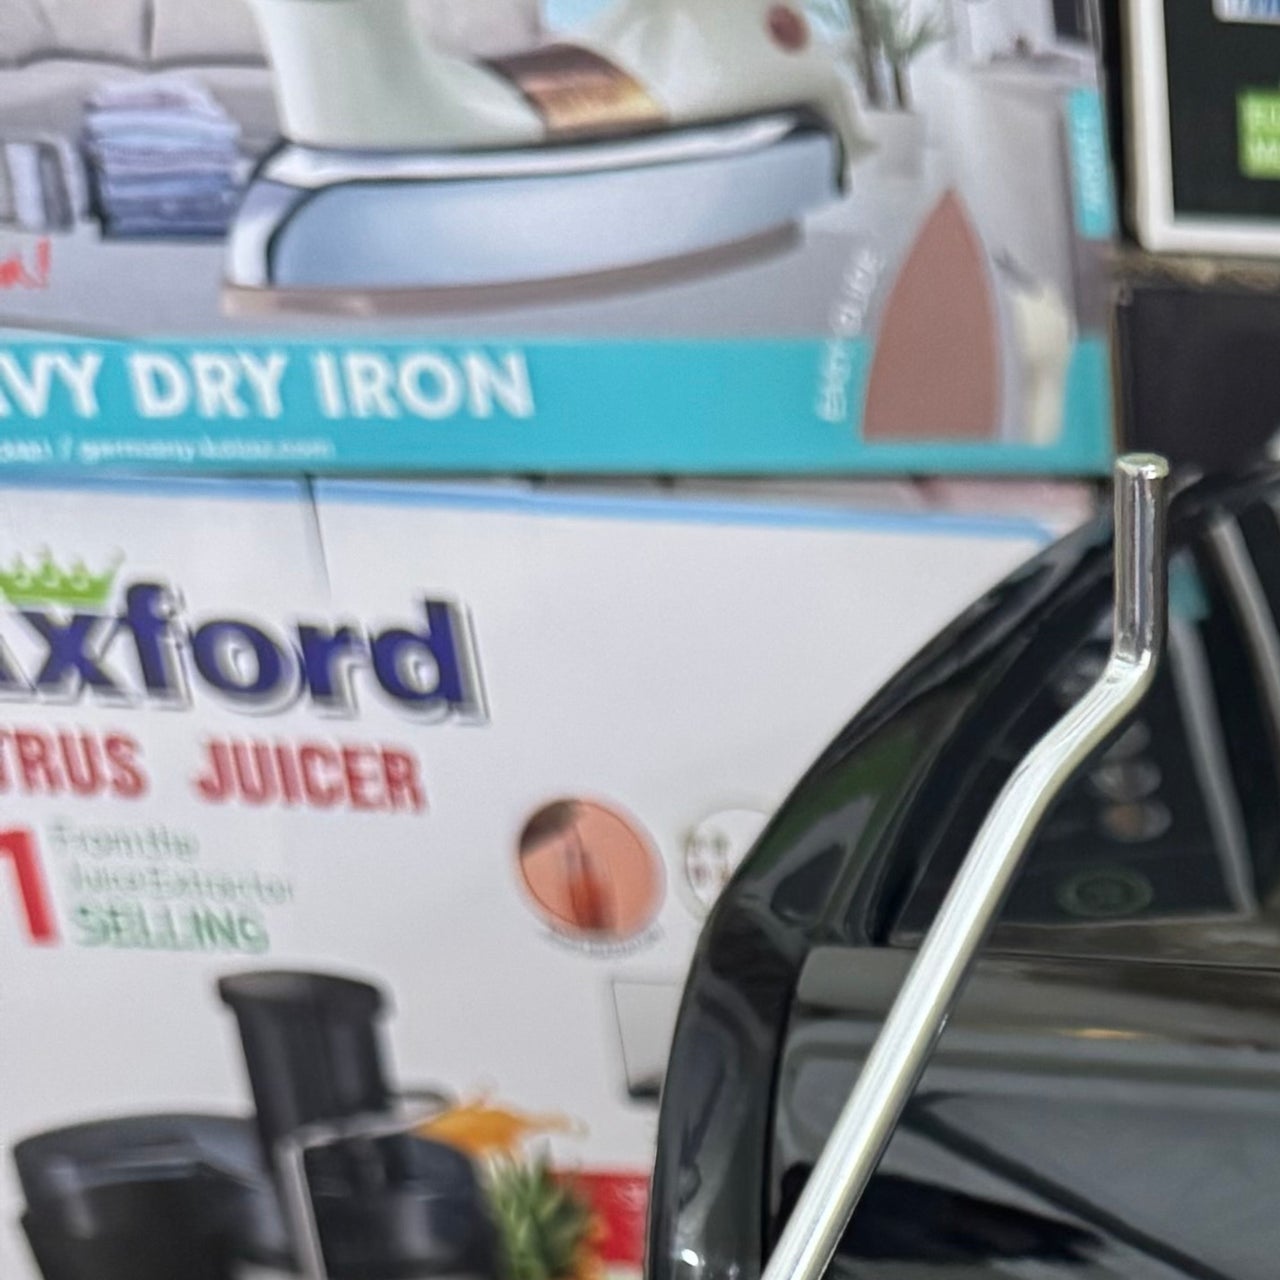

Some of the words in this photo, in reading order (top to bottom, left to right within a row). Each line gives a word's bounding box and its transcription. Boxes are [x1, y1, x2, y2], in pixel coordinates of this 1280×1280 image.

[0, 351, 102, 419] VY
[129, 350, 286, 419] DRY
[312, 350, 535, 419] IRON
[0, 580, 490, 725] xford
[192, 736, 429, 812] JUICER
